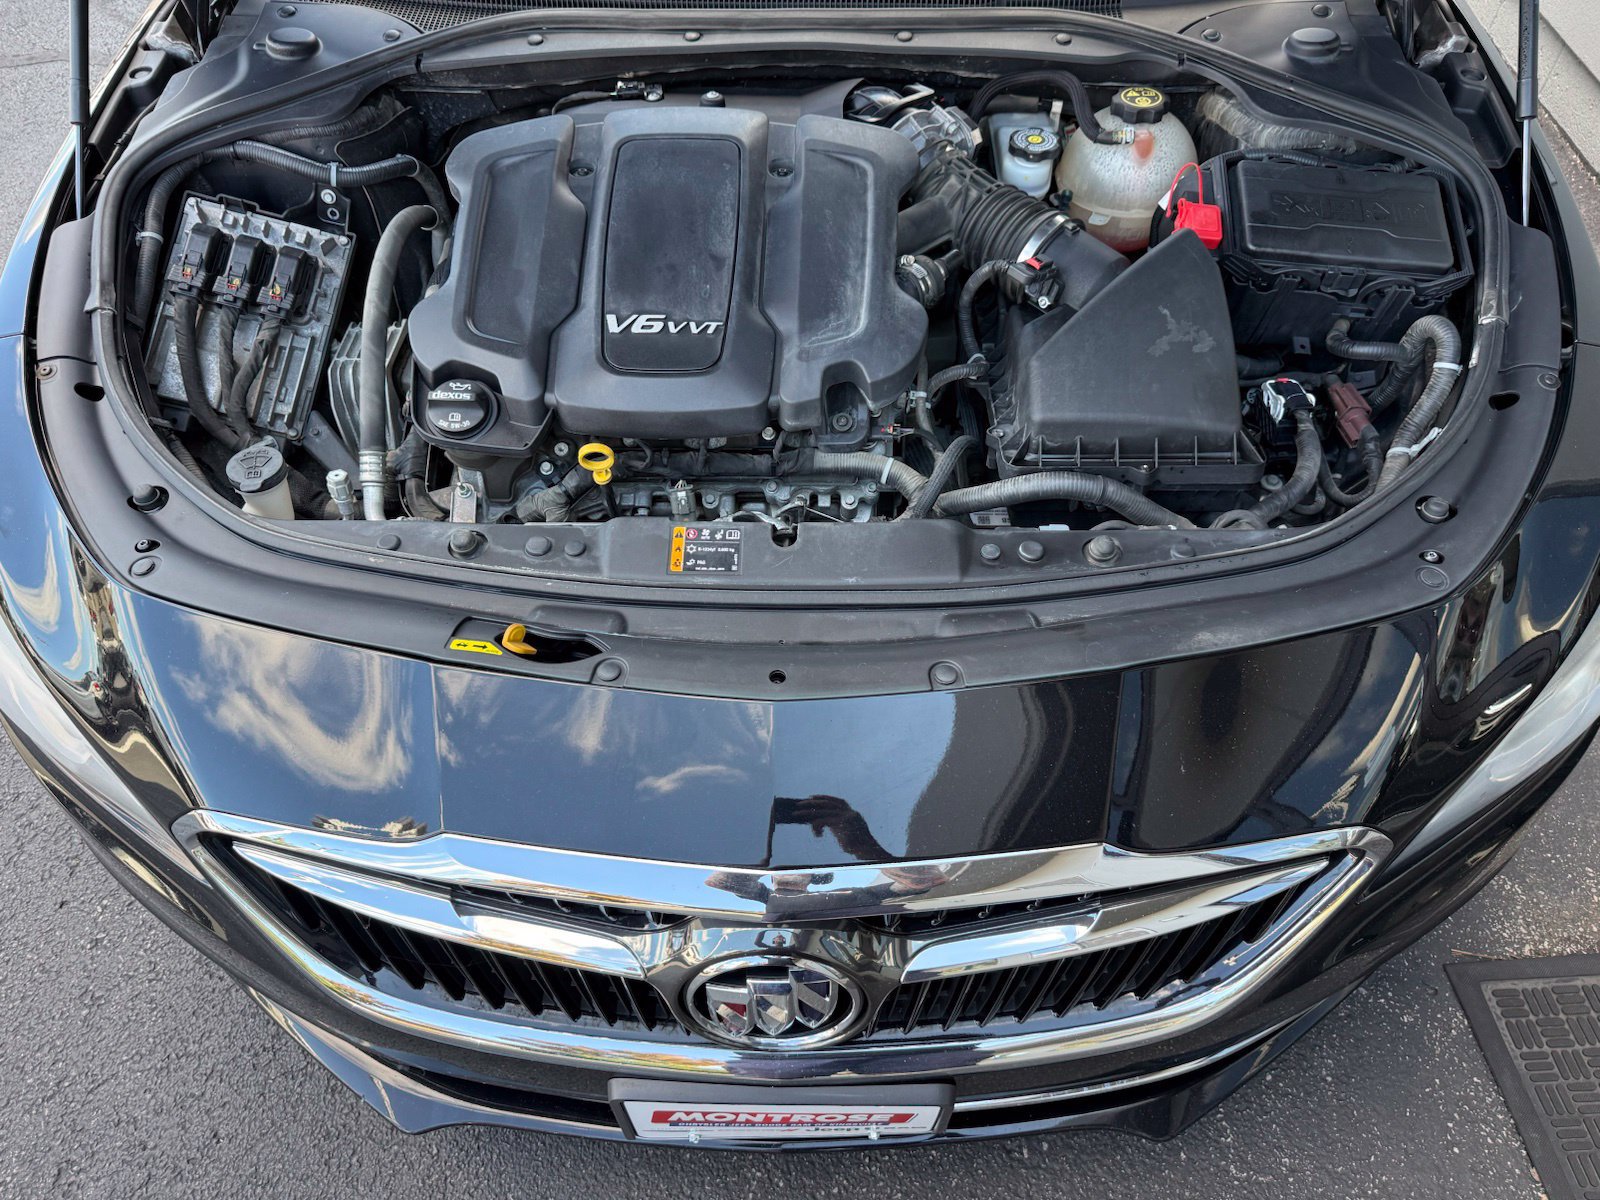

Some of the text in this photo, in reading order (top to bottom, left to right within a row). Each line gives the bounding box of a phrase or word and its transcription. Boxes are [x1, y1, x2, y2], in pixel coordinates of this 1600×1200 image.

[606, 314, 724, 334] V6 VVT
[432, 390, 471, 400] dexos
[450, 420, 471, 429] 5W-30
[667, 1111, 895, 1122] MONTROSE
